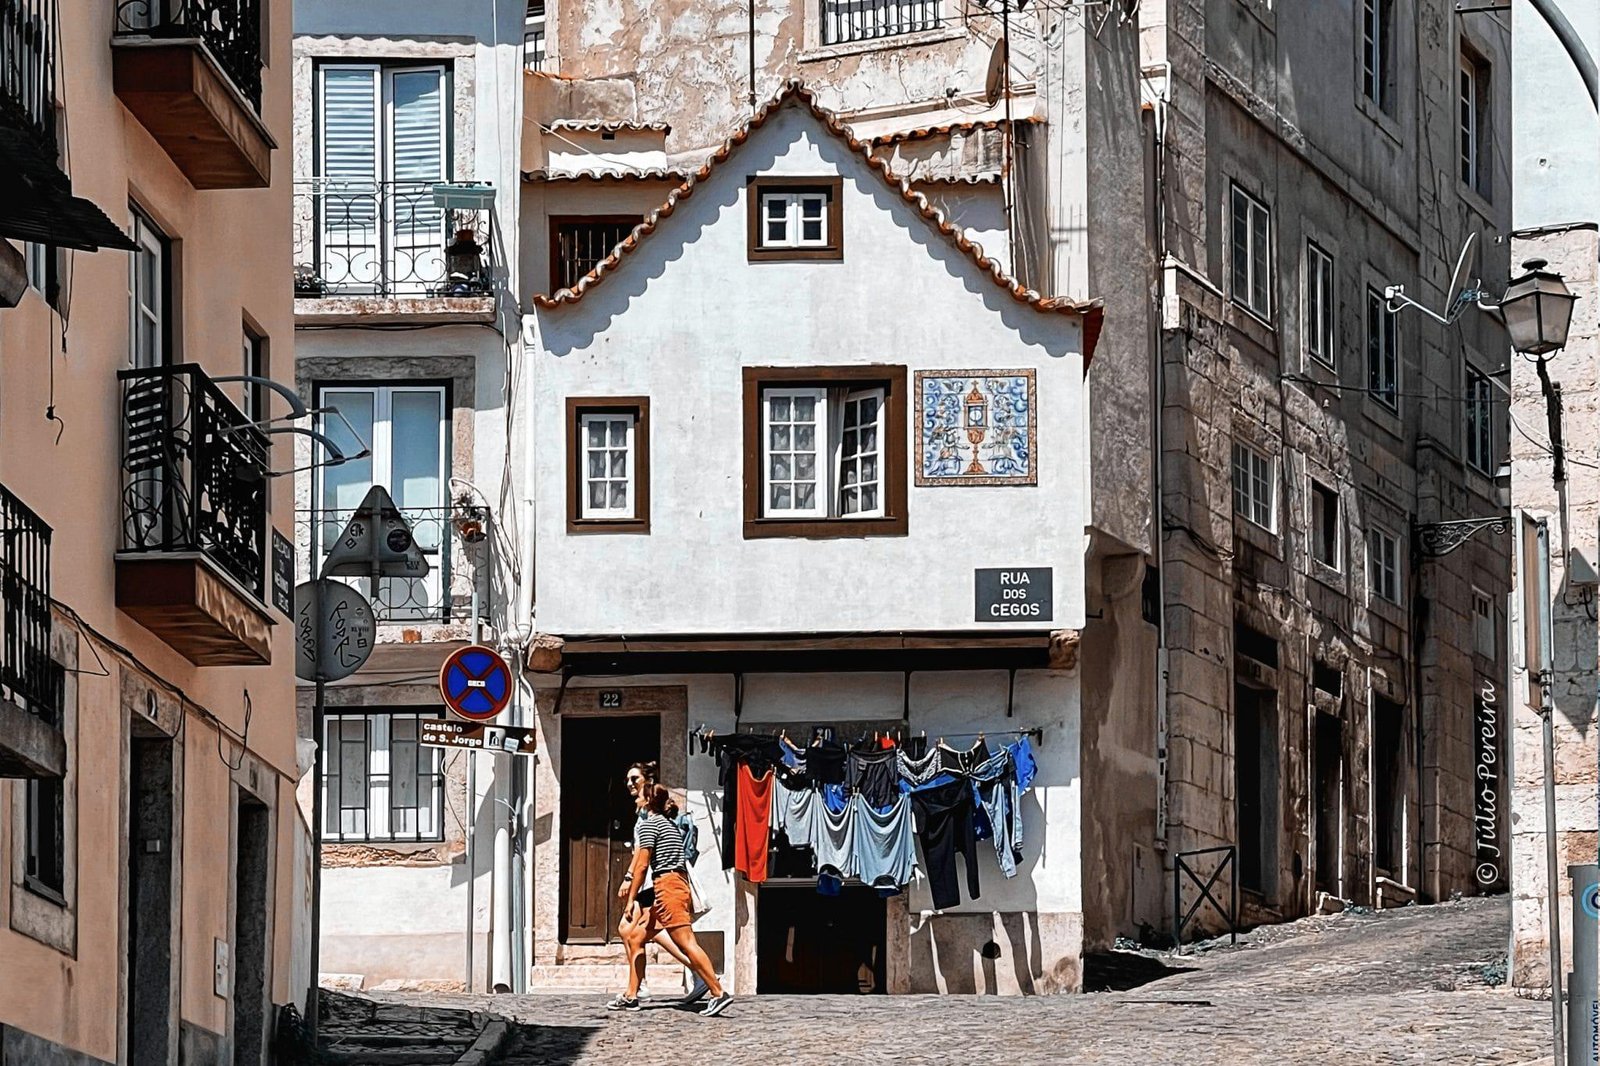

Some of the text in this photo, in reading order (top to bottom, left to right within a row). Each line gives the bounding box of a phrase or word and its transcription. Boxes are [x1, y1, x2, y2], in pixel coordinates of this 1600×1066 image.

[1000, 572, 1030, 585] RUA
[1003, 589, 1026, 599] DOS
[990, 603, 1040, 616] CEGOS
[603, 693, 619, 707] 22
[422, 733, 482, 747] de S. Jorge
